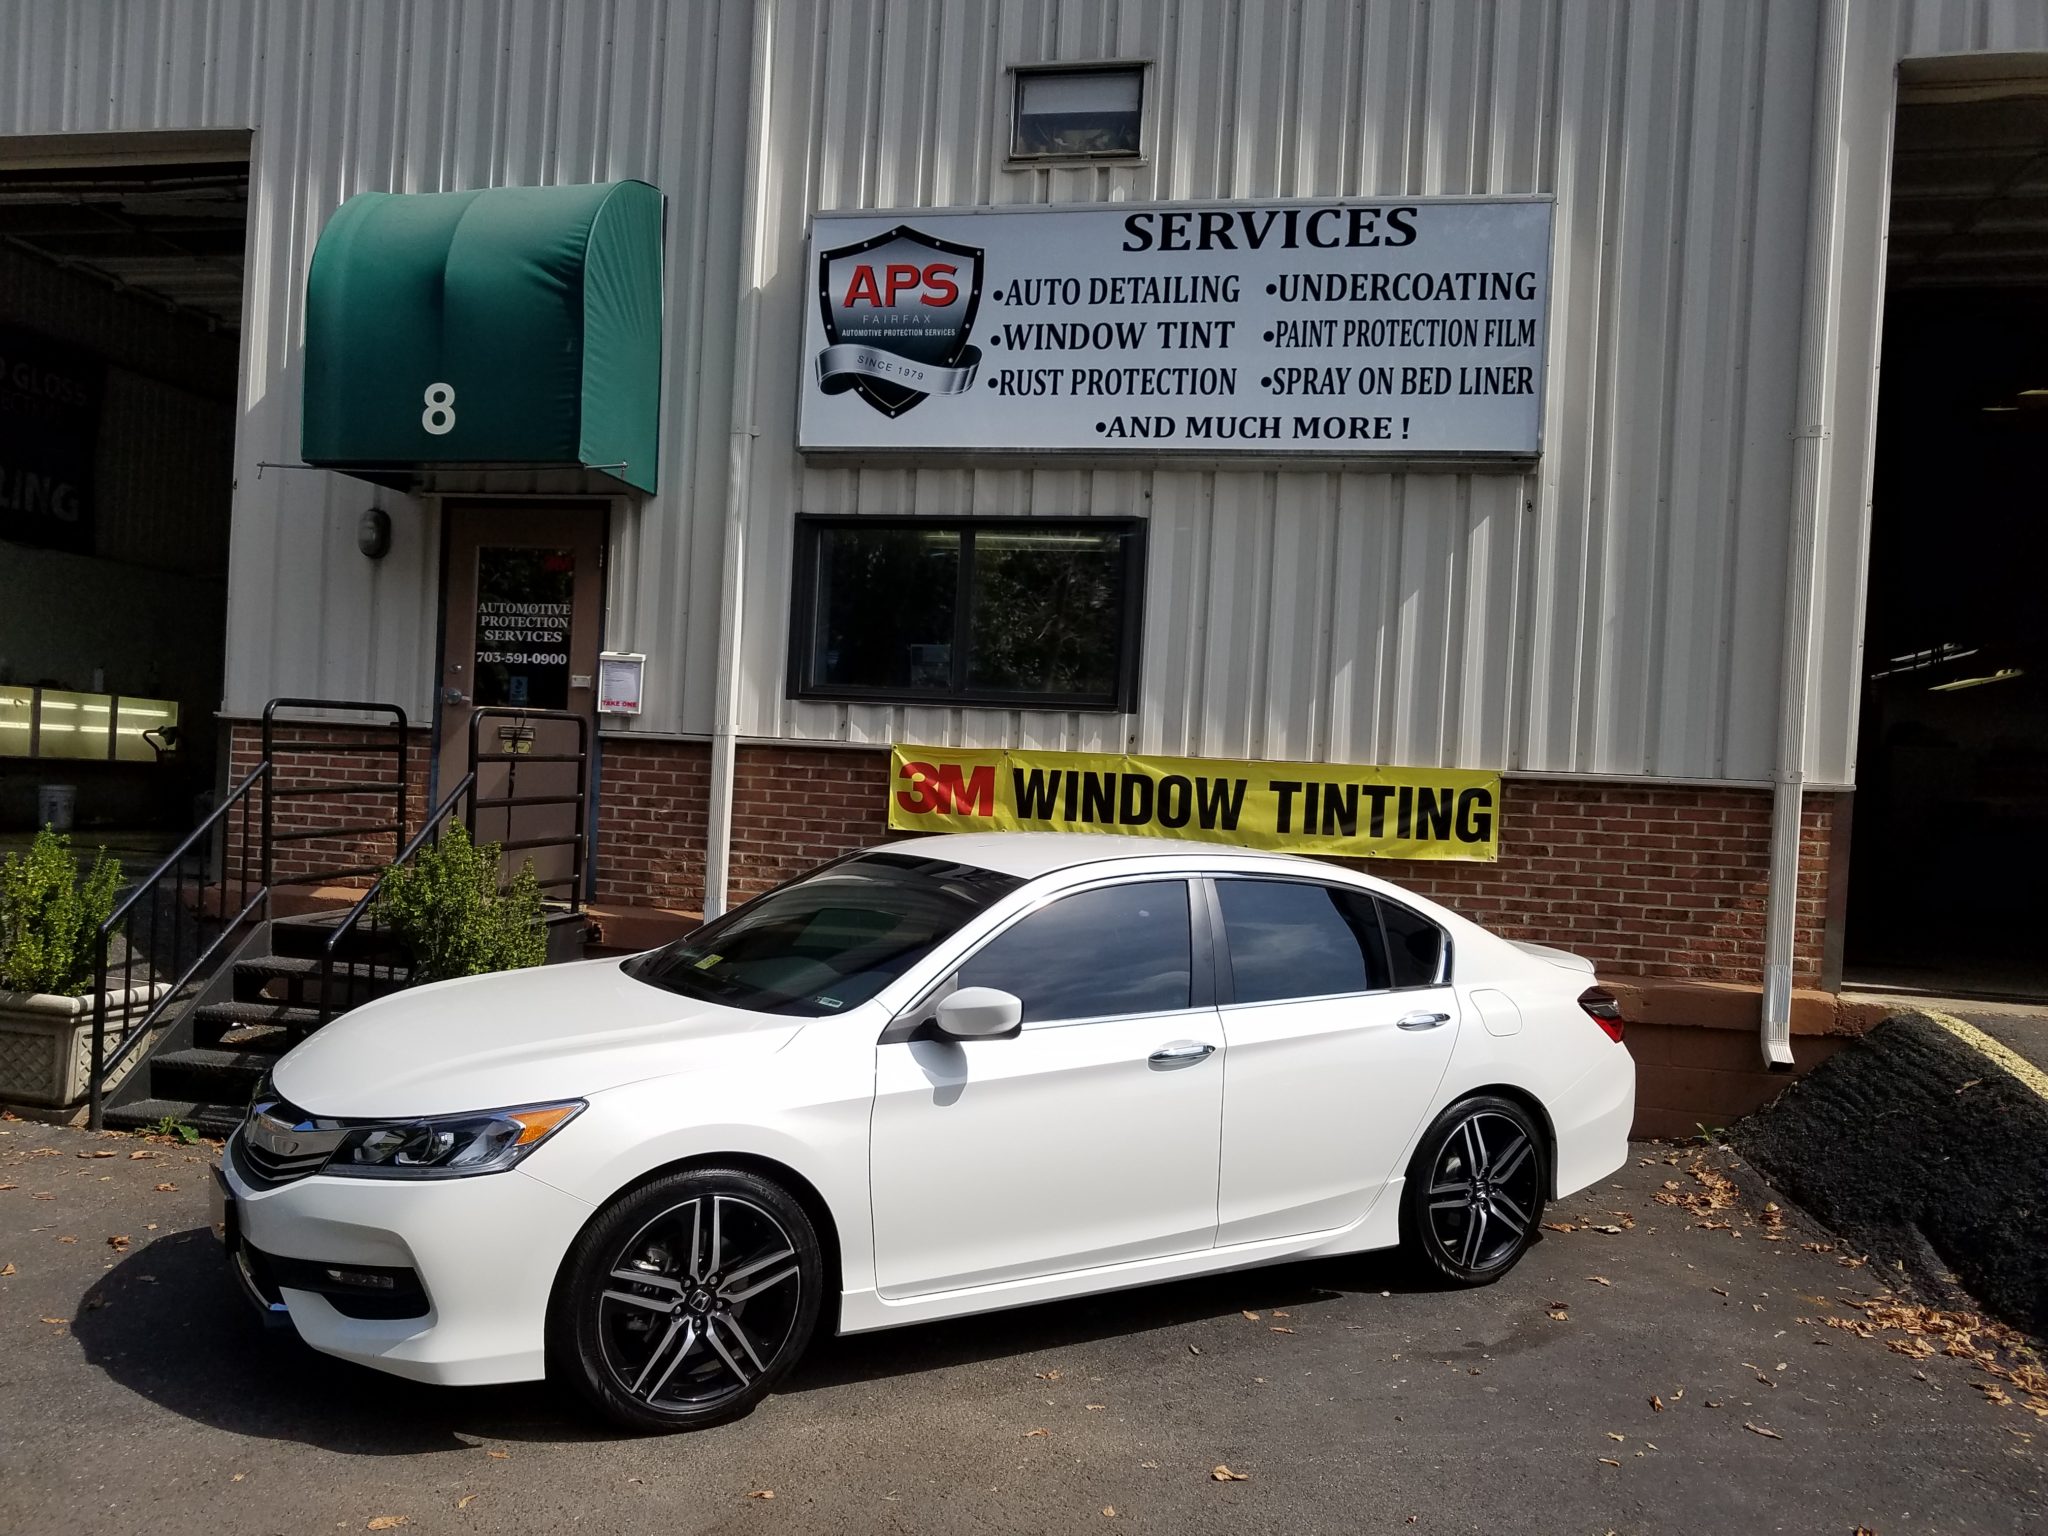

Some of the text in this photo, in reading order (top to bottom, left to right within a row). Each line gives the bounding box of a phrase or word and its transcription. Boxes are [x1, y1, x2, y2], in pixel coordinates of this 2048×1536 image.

[1122, 207, 1418, 252] SERVICES
[842, 263, 960, 309] APS
[1004, 274, 1240, 306] AUTO DETAILING
[1278, 271, 1537, 302] UNDERCOATING
[841, 328, 956, 337] AUTOMOTIVE PROTECTION SERVICES
[862, 314, 932, 324] FAIRFAX
[1274, 318, 1537, 348] PAINT PROTECTION FILM
[1003, 320, 1236, 351] WINDOW TINT
[857, 354, 924, 381] SINCE 1979
[998, 367, 1238, 397] RUST PROTECTION
[1271, 366, 1535, 396] SPRAY ON BED LINER
[421, 382, 456, 435] 8
[1104, 415, 1176, 439] AND
[1185, 415, 1282, 440] MUCH
[478, 602, 572, 616] AUTOMOTIVE
[481, 615, 569, 629] PROTECTION
[484, 629, 563, 643] SERVICES
[476, 651, 568, 665] 703-591-0900
[896, 761, 1493, 843] 3M WINDOW TINTING
